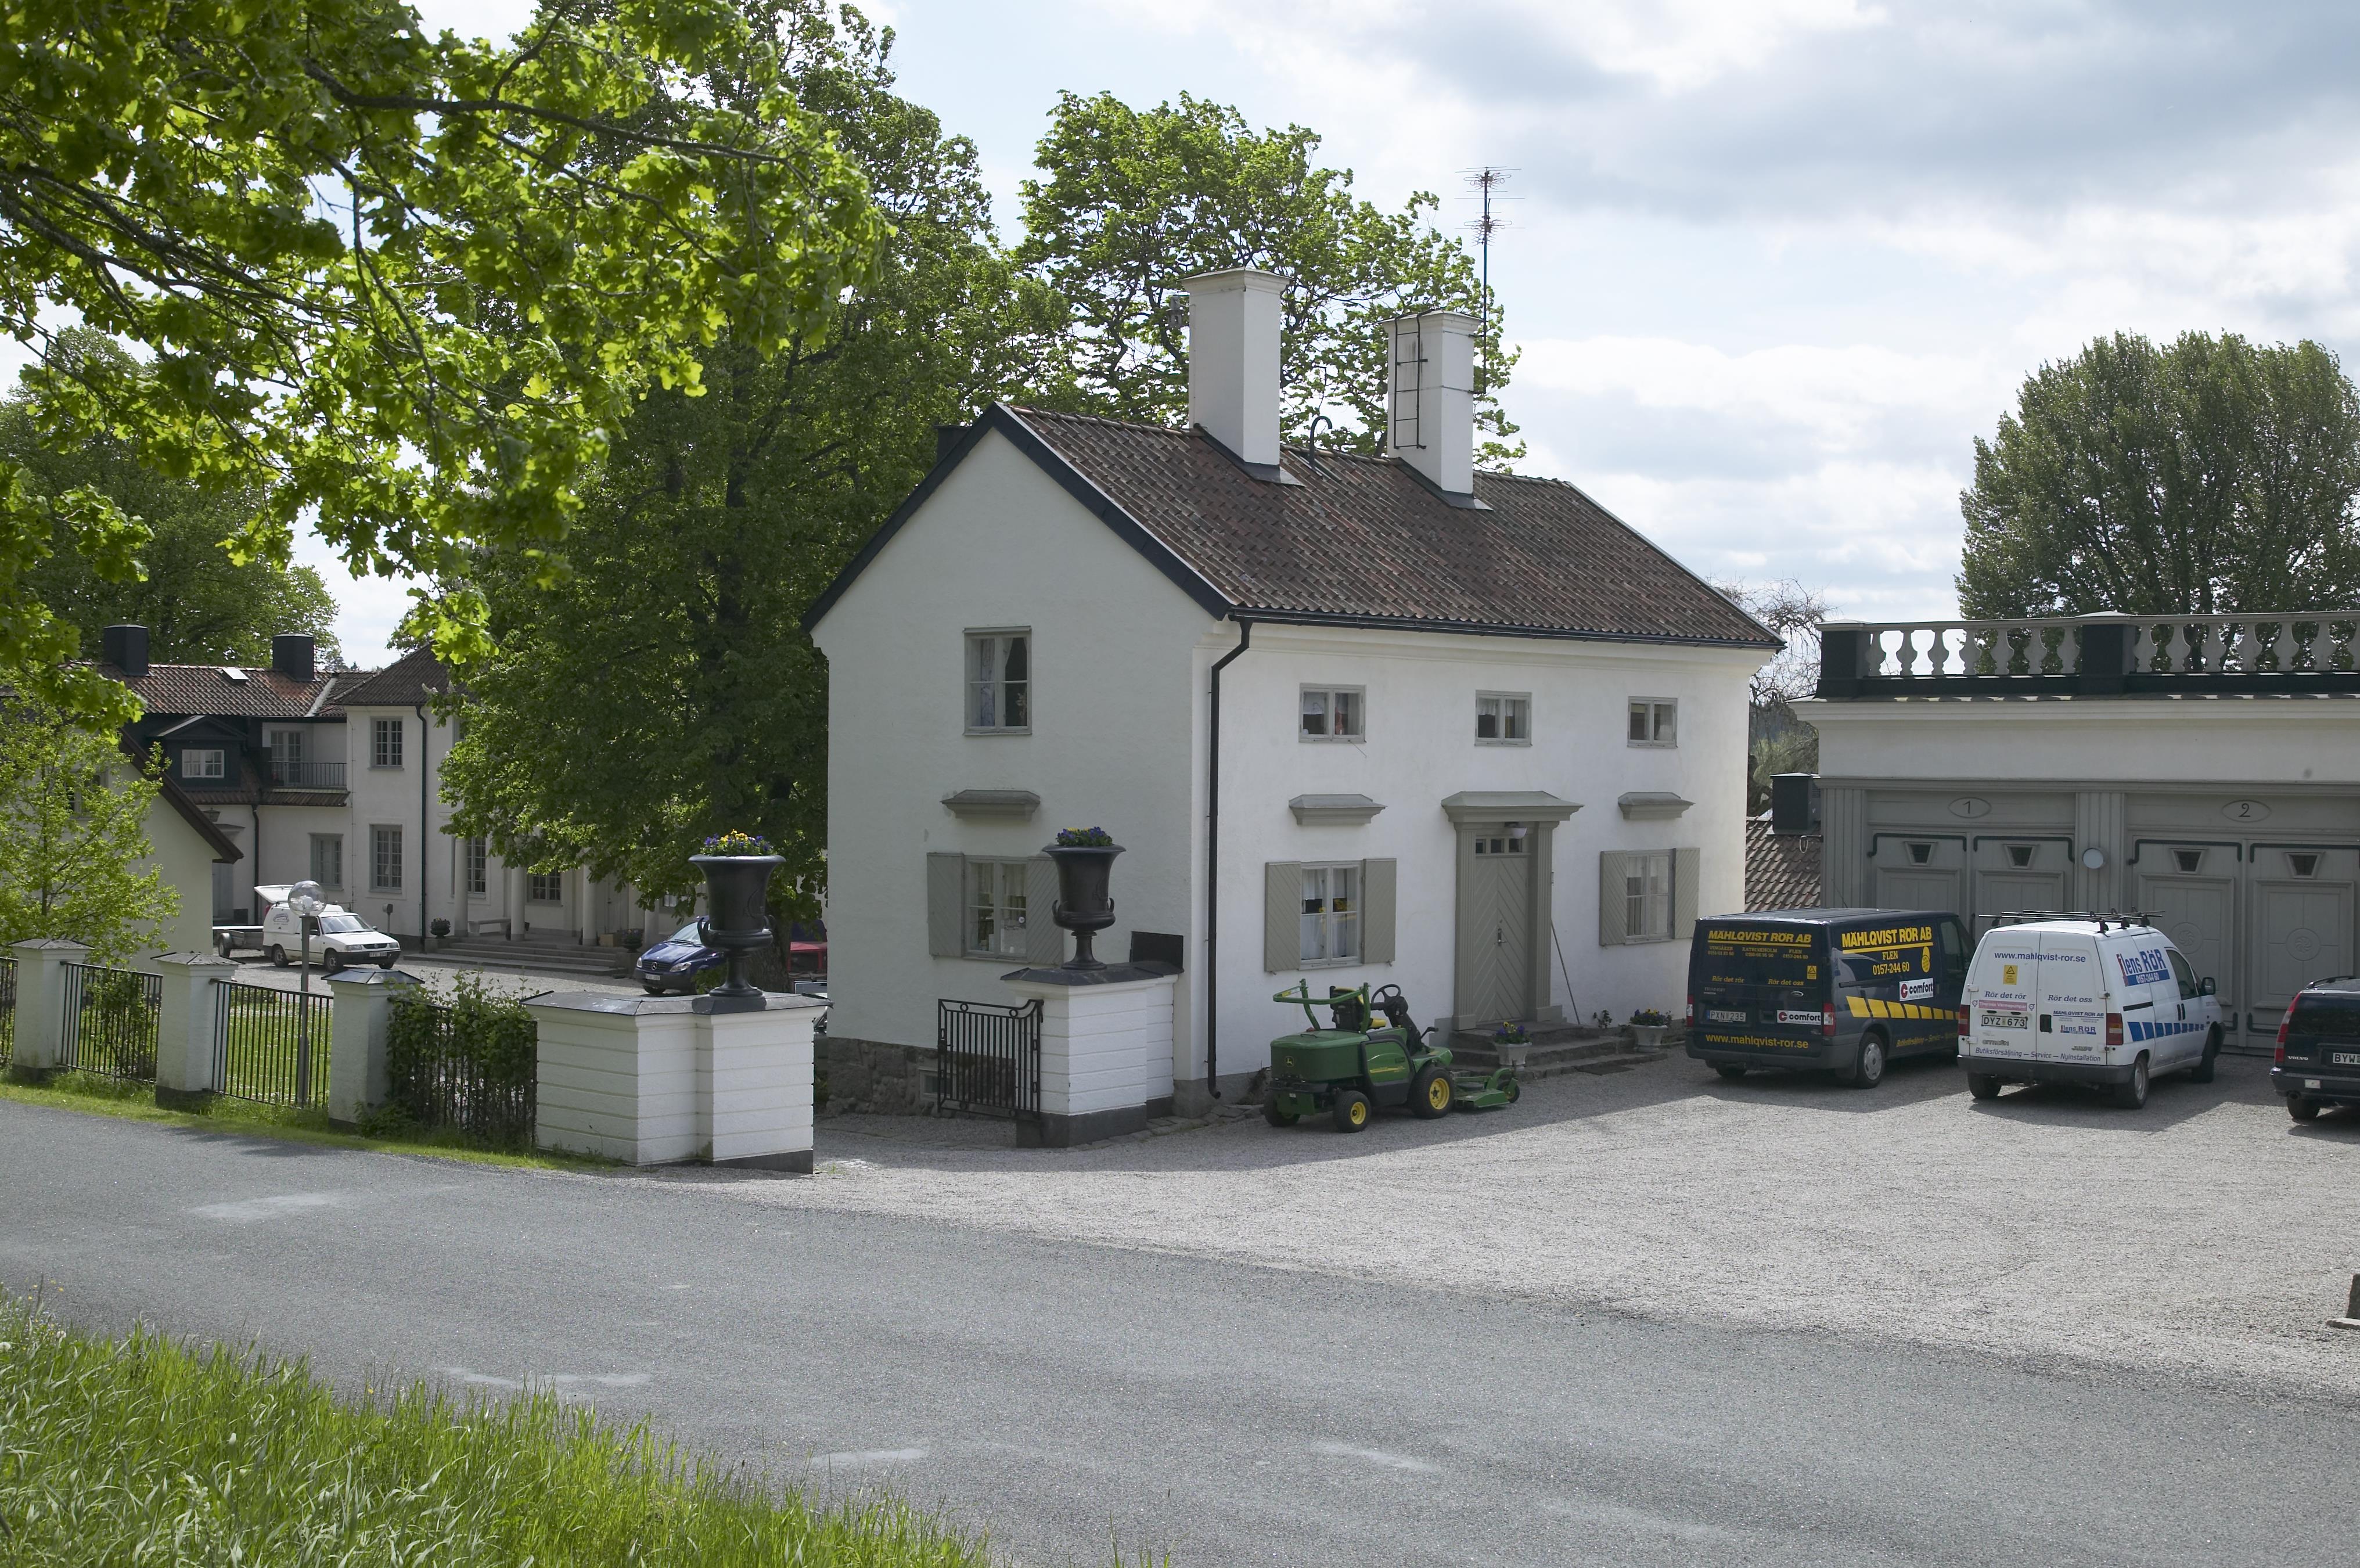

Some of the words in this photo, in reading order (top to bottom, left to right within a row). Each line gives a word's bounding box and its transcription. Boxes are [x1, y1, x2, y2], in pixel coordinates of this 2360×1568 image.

[1963, 800, 1970, 814] 1
[2238, 803, 2251, 817] 2
[1708, 930, 1769, 941] MÄHLQVIST
[1770, 932, 1794, 943] RÖR
[1796, 934, 1812, 943] AB
[1841, 930, 1897, 948] MÄHLQVIST
[1899, 927, 1918, 942] RÖR
[1920, 926, 1932, 941] AB
[1882, 951, 1898, 961] FLEN
[1994, 952, 2086, 962] www.mahlqvist-ror.se
[1873, 963, 1901, 976] 0157-244
[1902, 961, 1910, 972] 60
[1909, 981, 1933, 995] comfort
[1711, 1011, 1725, 1020] PXN
[1730, 1013, 1744, 1021] 235
[1789, 1013, 1821, 1022] comfort
[1984, 1017, 2001, 1026] DYZ
[2007, 1019, 2026, 1027] 673
[1706, 1034, 1809, 1048] www.mahlqvist-ror.se
[1976, 1047, 2022, 1058] Butiksförsäljning
[2060, 1053, 2101, 1062] Nyinstallation
[2334, 1053, 2355, 1063] BYW
